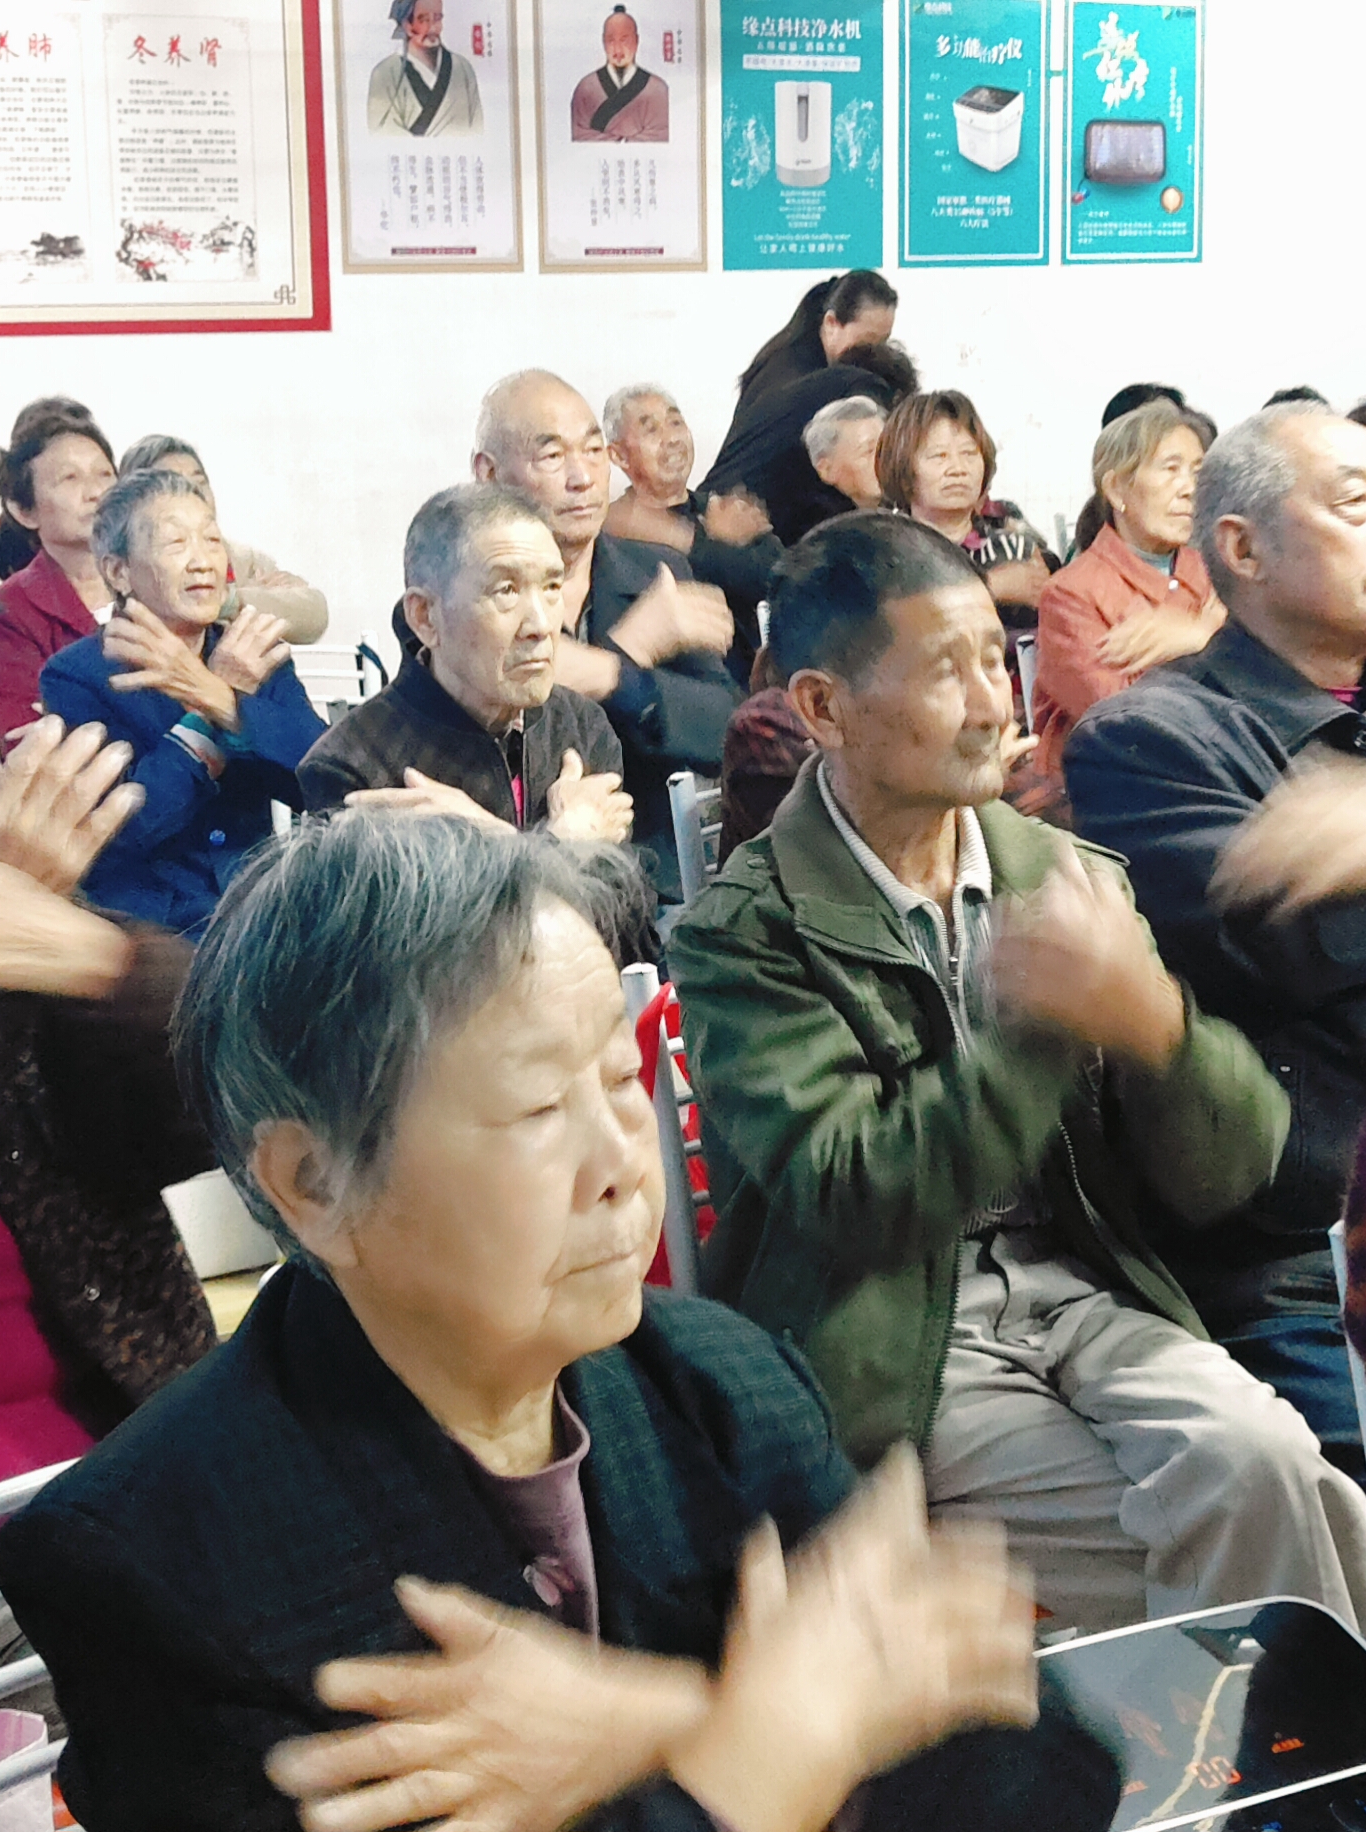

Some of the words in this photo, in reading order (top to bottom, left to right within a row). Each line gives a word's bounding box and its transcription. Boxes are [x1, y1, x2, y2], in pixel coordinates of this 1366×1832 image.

[742, 15, 862, 40] 缘点科技净水机
[127, 35, 223, 67] 冬养肾
